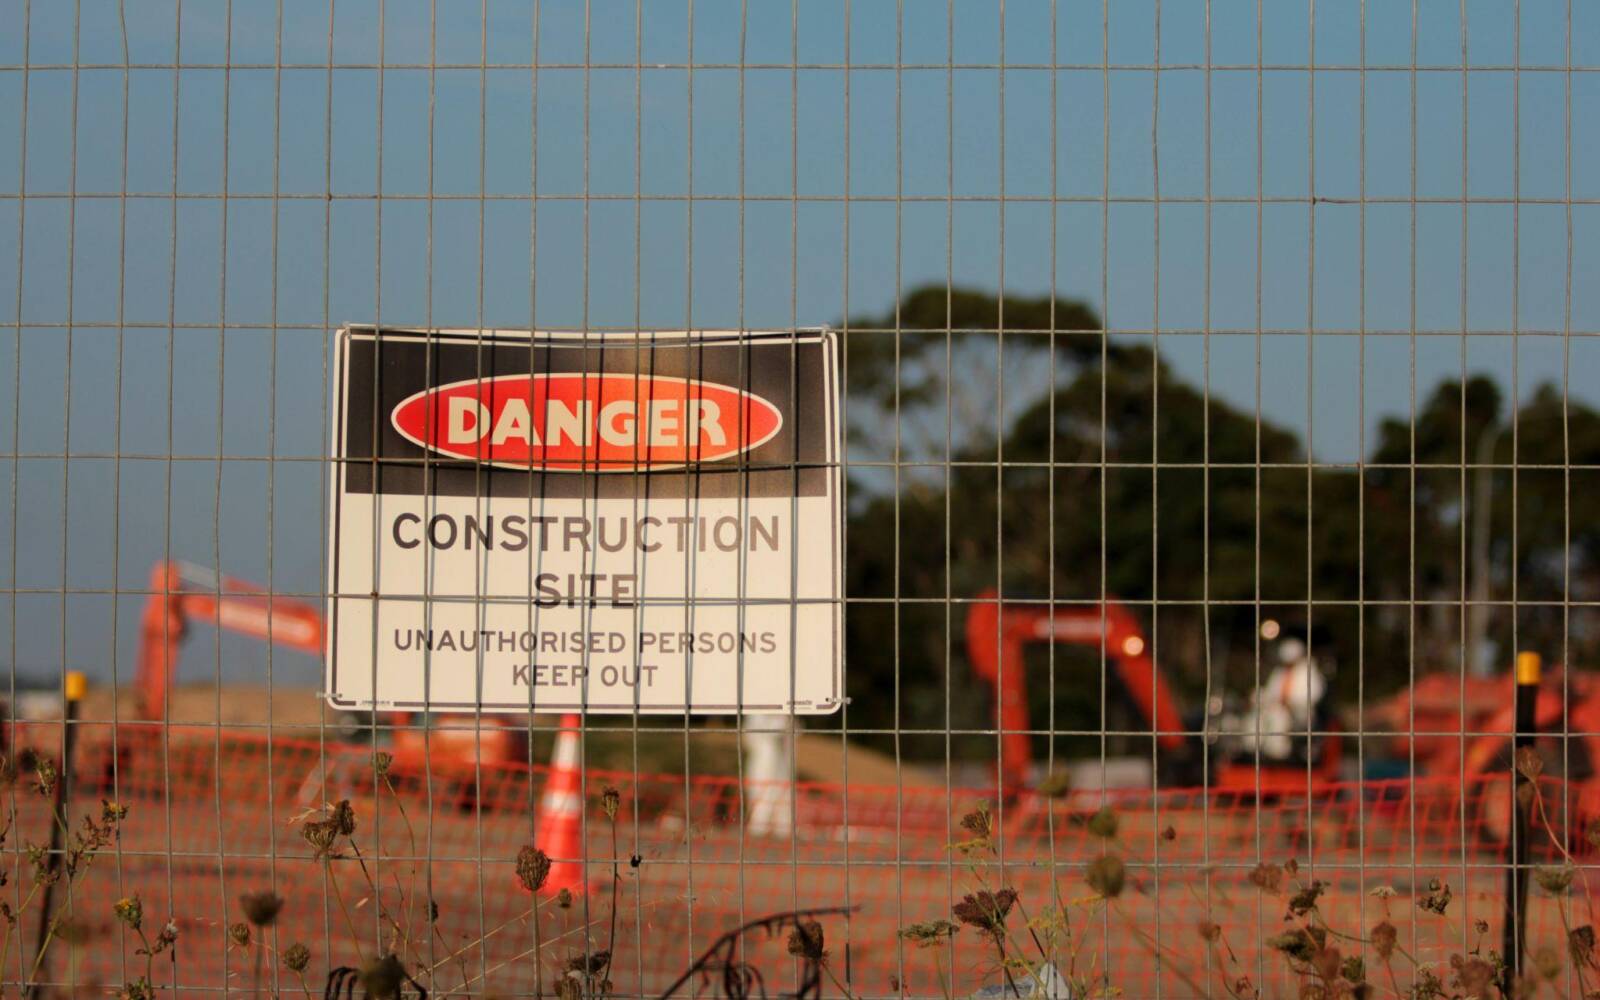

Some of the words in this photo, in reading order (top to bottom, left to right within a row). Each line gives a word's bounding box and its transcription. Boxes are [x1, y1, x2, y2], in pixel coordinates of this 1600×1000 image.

[448, 396, 727, 447] DANGER
[393, 513, 779, 553] CONSTRUCTION
[535, 573, 638, 609] SITE
[394, 629, 626, 654] UNAUTHORISED
[640, 632, 777, 654] PERSONS
[513, 664, 588, 687] KEEP
[600, 664, 658, 688] OUT
